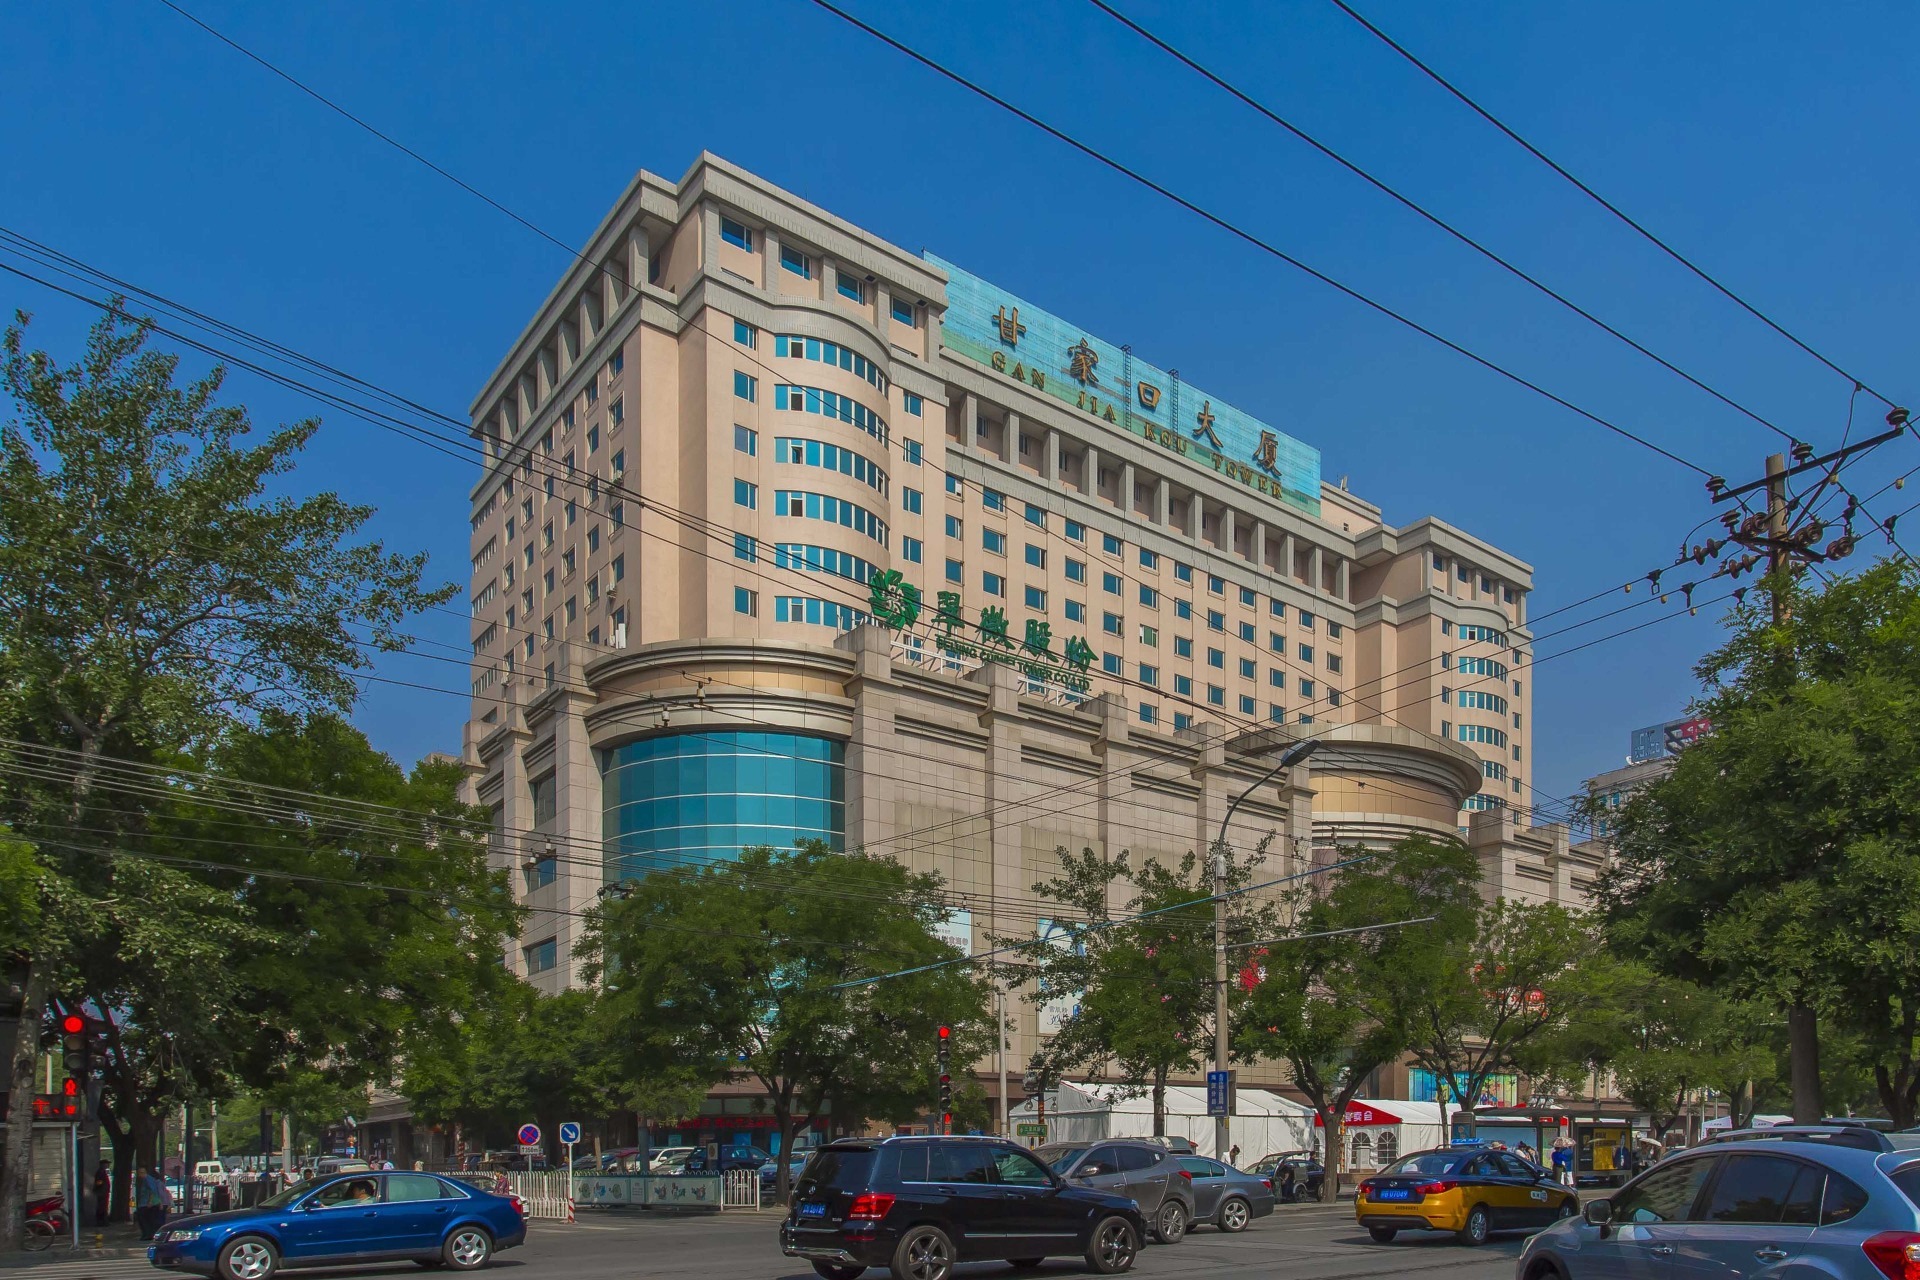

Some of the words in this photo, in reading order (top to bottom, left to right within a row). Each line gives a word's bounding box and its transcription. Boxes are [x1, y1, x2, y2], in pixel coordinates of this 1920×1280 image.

[992, 305, 1282, 476] 甘家口大厦
[992, 351, 1045, 391] GAN
[1077, 391, 1117, 423] JIA
[1144, 422, 1189, 457] KOU
[1211, 455, 1283, 499] TOWER
[931, 590, 1099, 673] 翠微股份
[936, 637, 977, 659] BEIJING
[1016, 661, 1052, 680] TOWER
